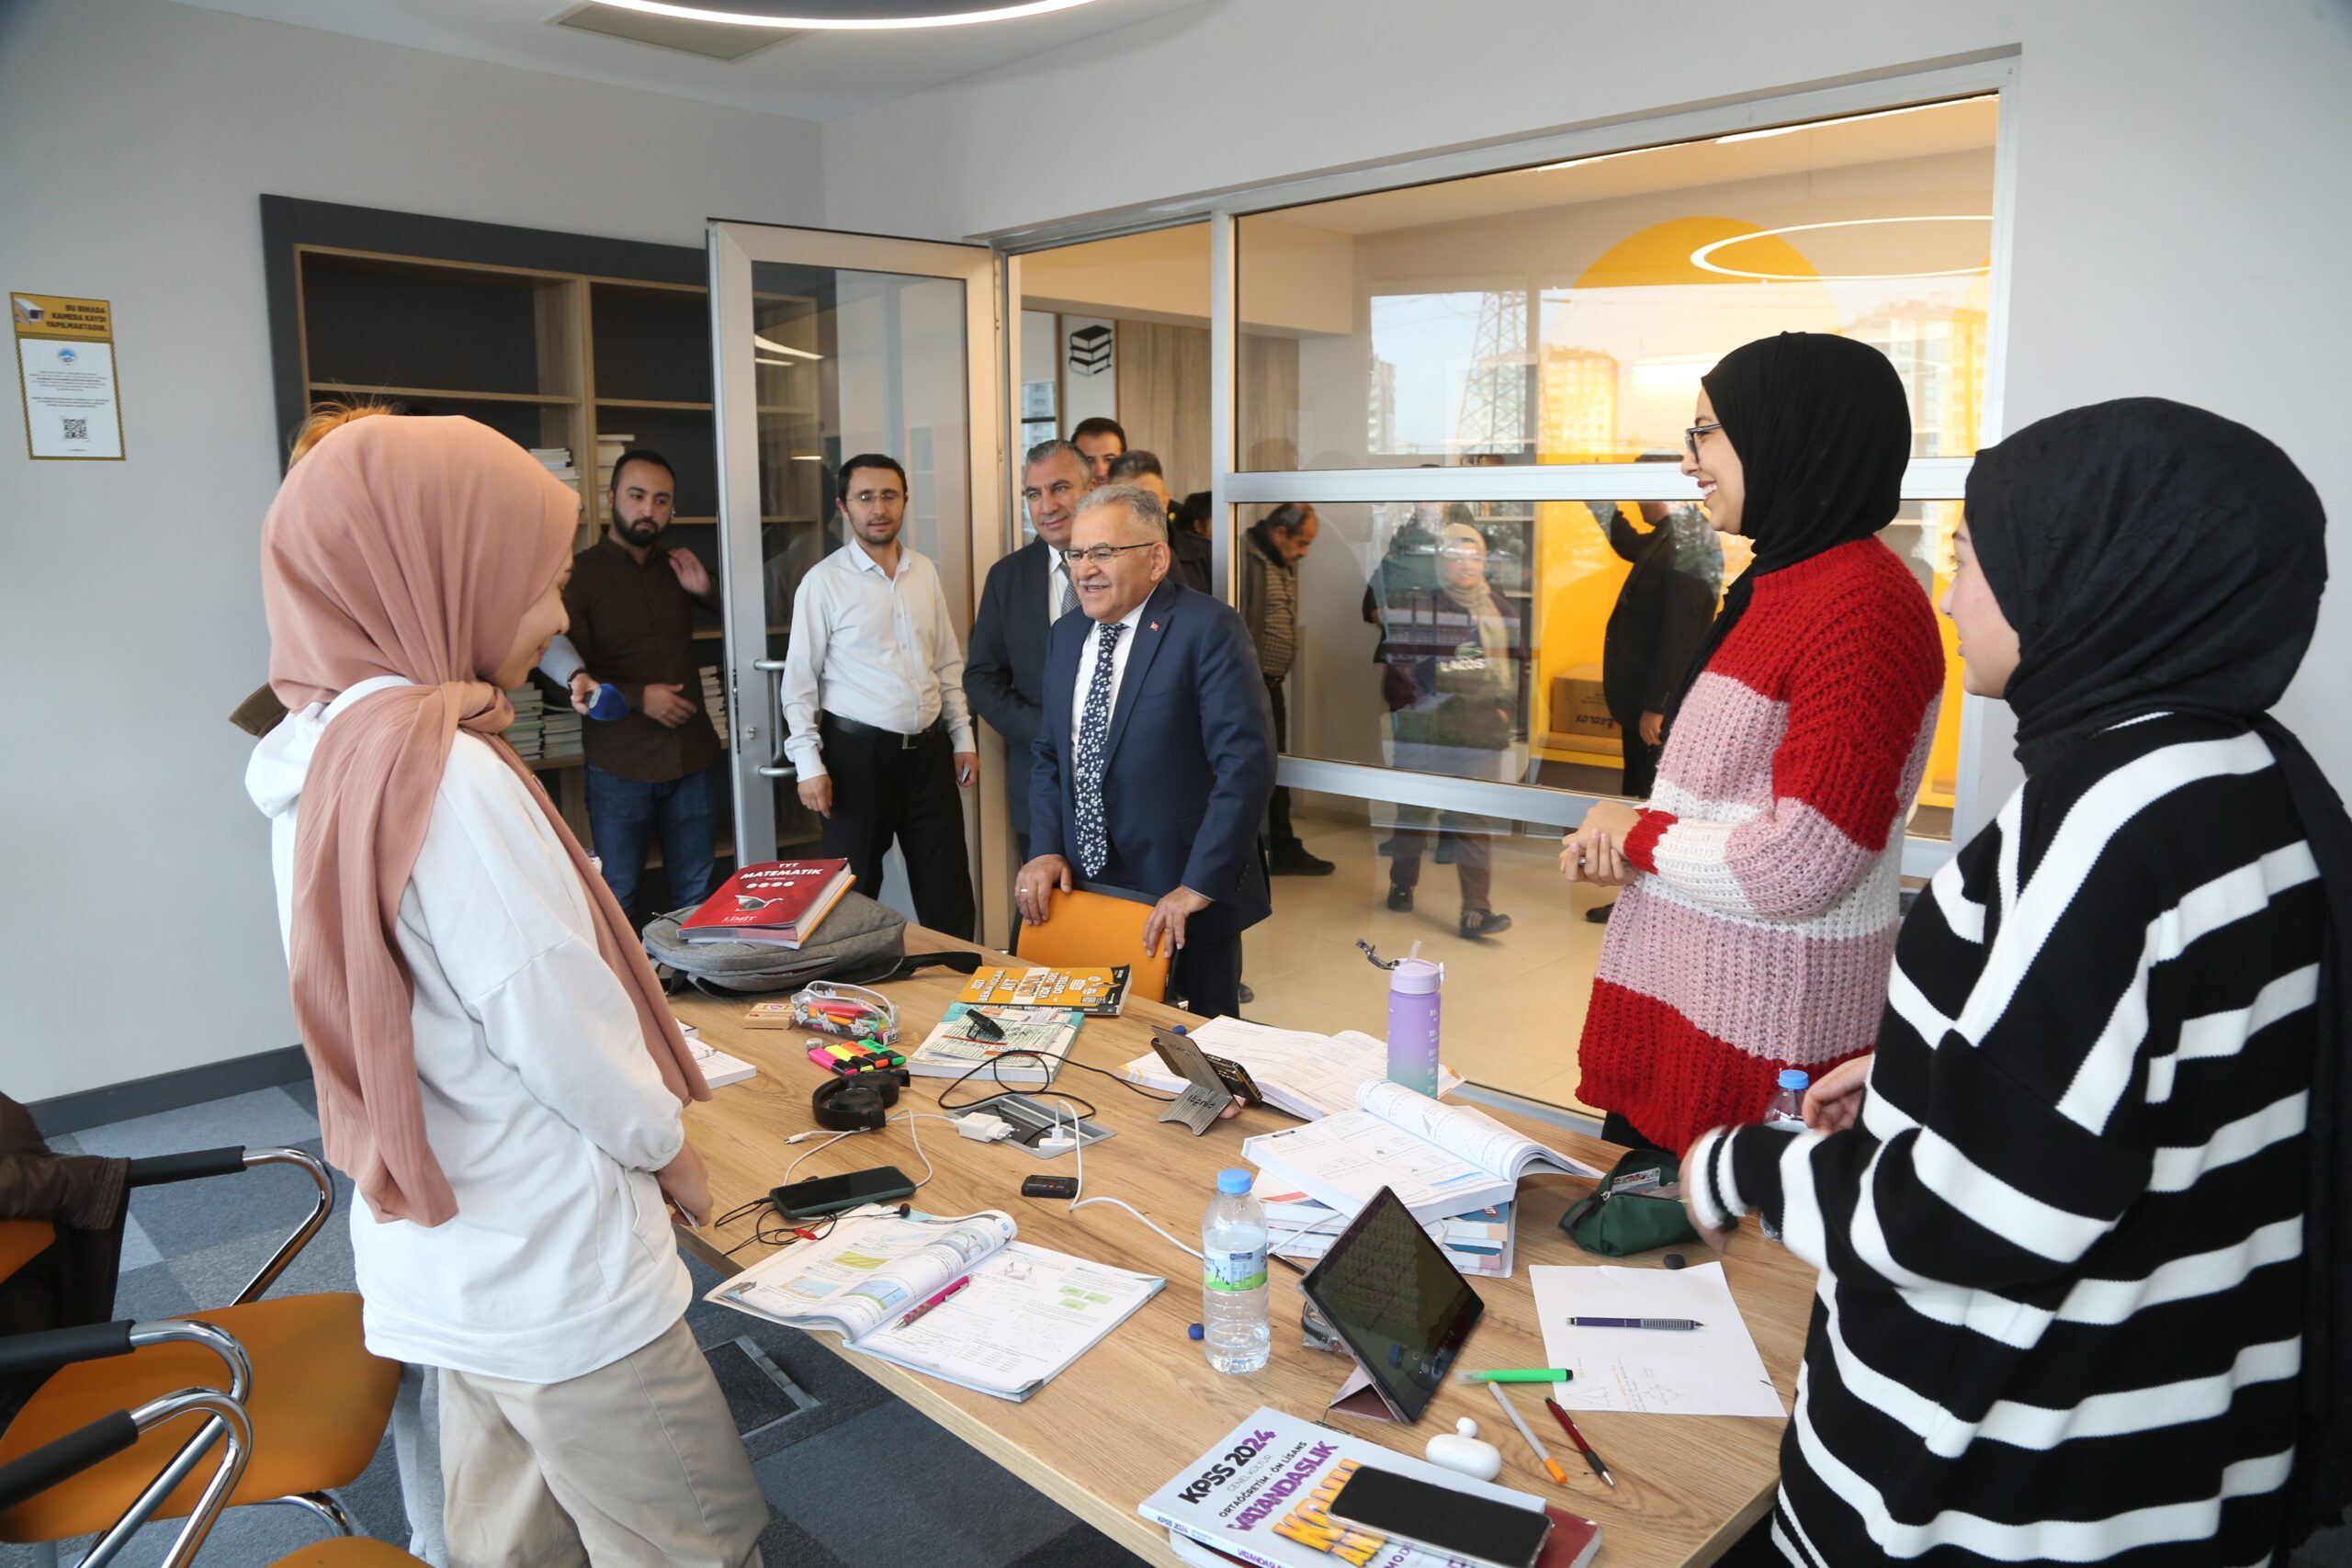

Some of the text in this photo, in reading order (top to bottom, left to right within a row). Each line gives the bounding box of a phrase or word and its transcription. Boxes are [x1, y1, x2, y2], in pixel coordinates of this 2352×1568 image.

[1283, 1441, 1307, 1463] LİSANS
[1178, 1429, 1276, 1505] KPSS 2024
[1227, 1474, 1250, 1492] GENEL
